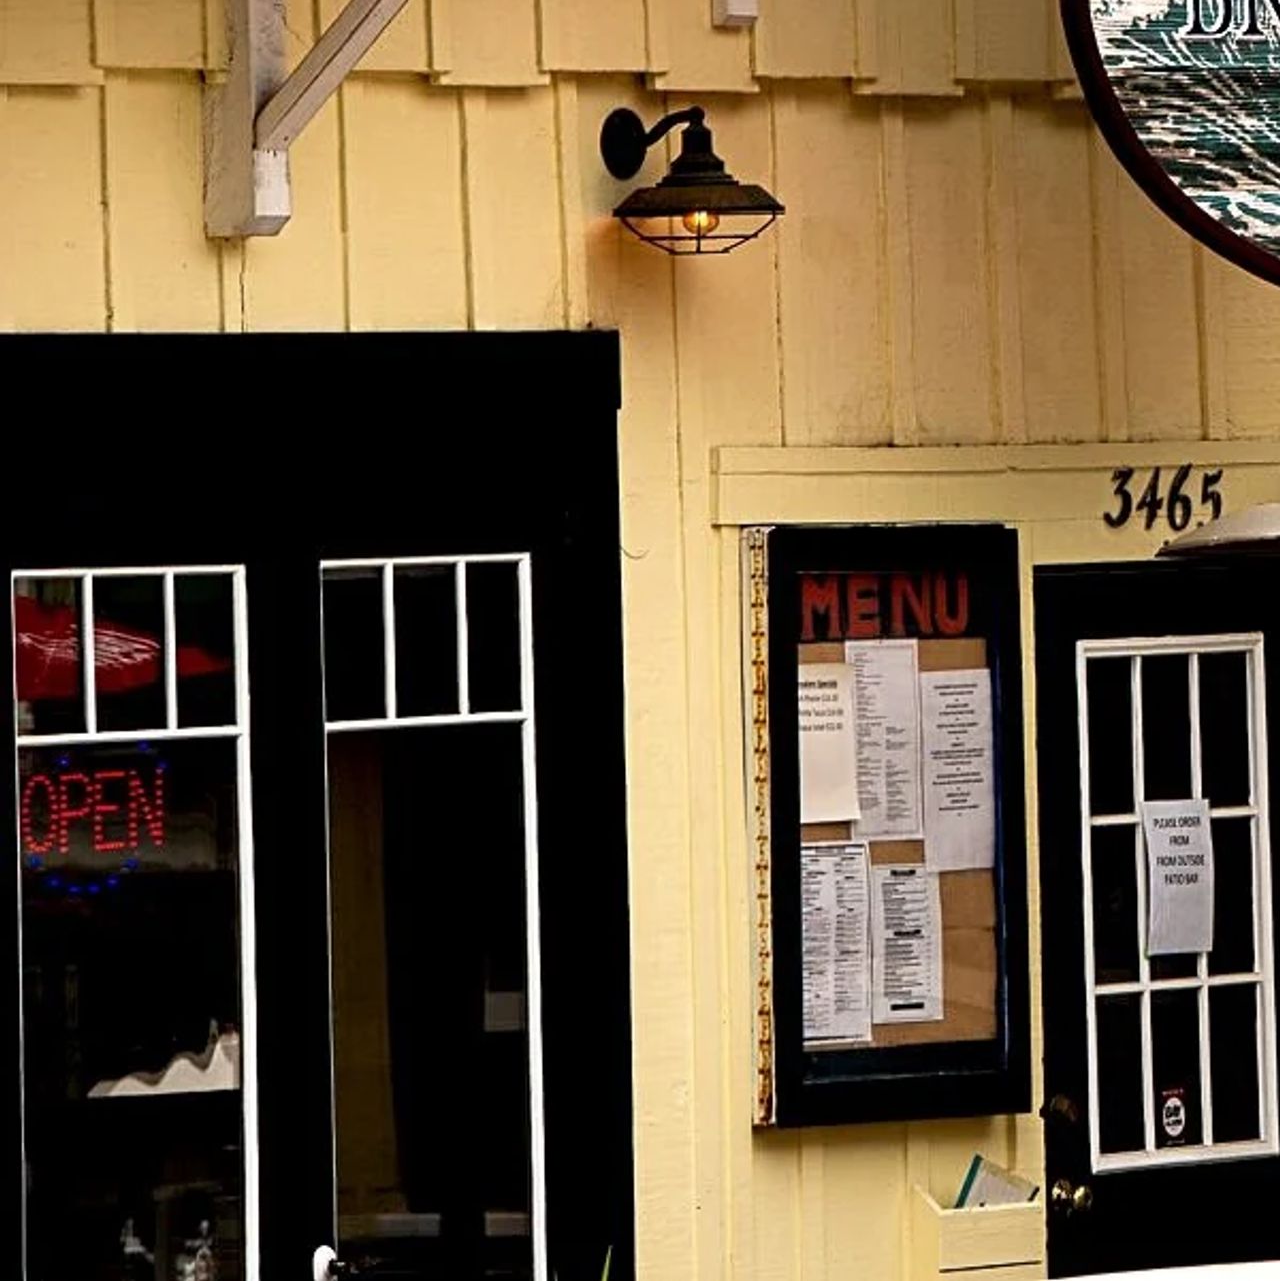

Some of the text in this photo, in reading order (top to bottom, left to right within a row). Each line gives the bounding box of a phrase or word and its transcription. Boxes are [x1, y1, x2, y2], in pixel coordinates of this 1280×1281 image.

[1103, 463, 1223, 530] 3465
[801, 572, 969, 640] MENU
[22, 768, 165, 853] OPEN
